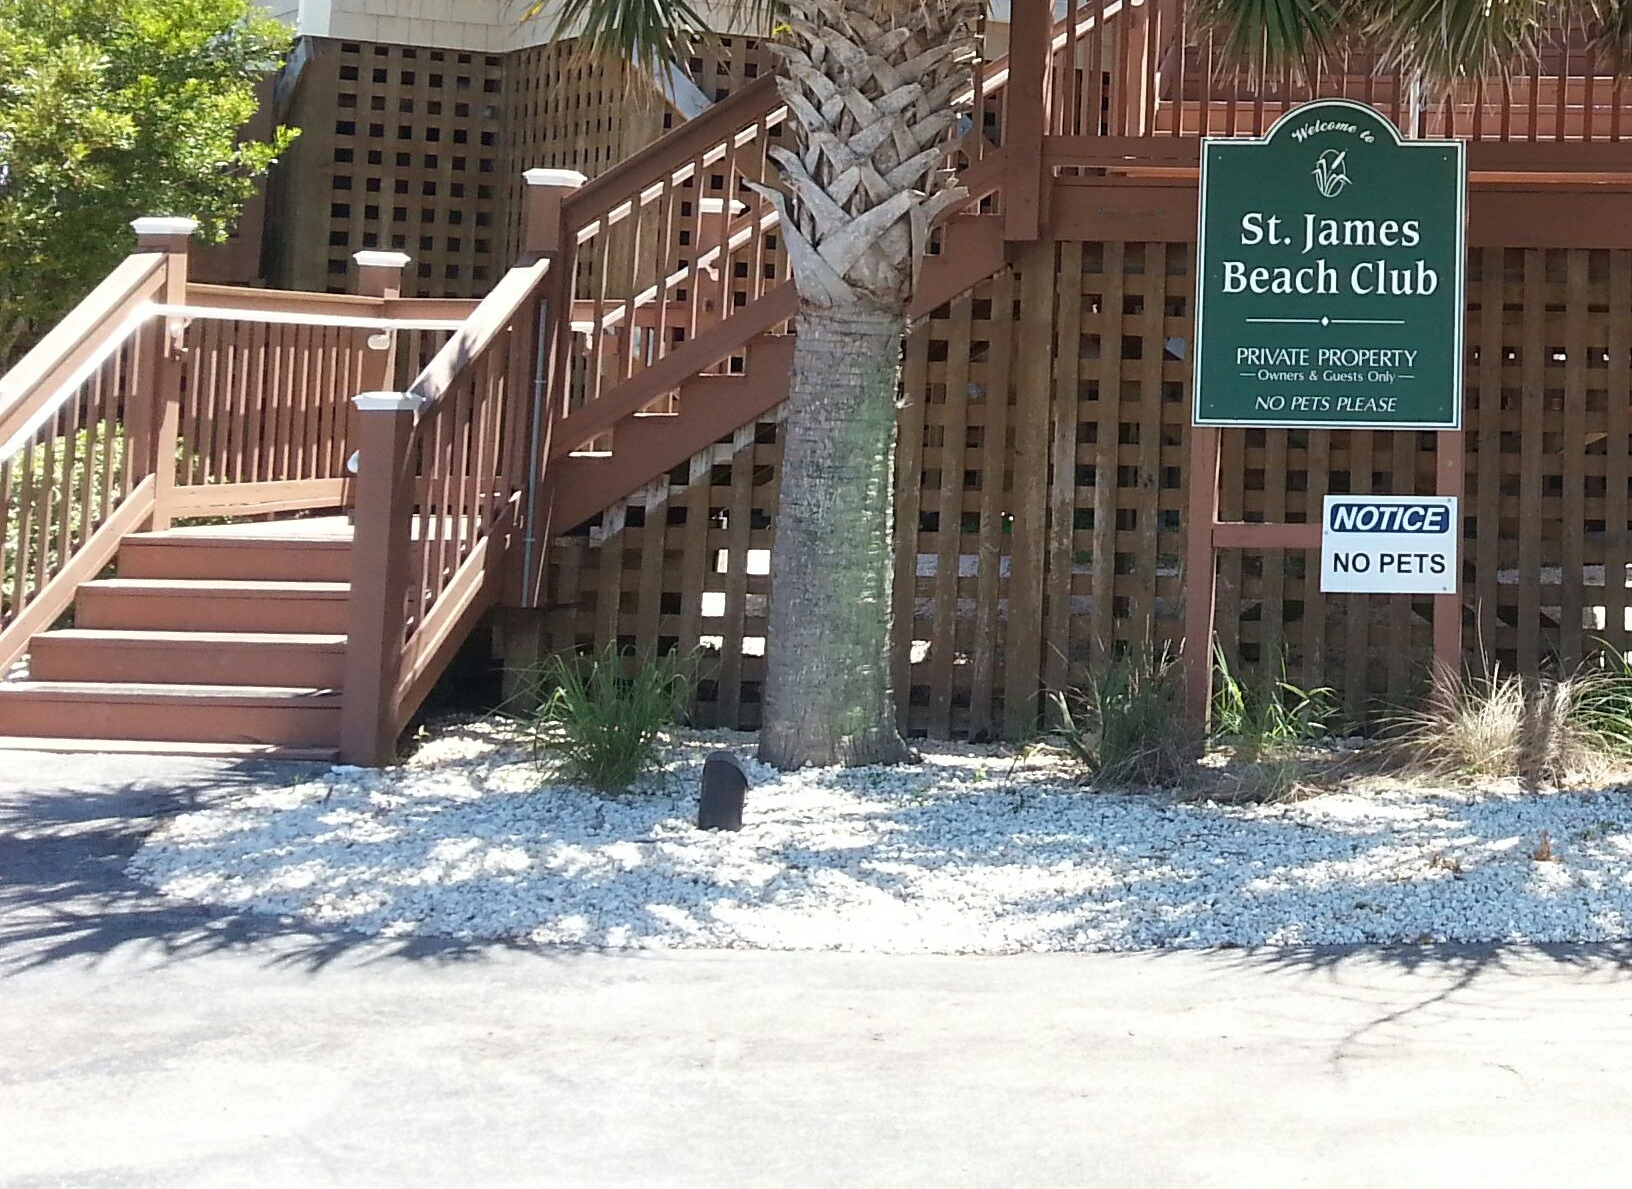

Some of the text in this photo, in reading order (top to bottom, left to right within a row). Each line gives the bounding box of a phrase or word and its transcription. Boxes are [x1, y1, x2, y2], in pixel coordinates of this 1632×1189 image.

[1291, 119, 1375, 144] Welcome to
[1240, 212, 1420, 254] St. James
[1222, 258, 1438, 296] Beach Club
[1236, 347, 1418, 367] PRIVATE PROPERTY
[1257, 369, 1396, 384] Owners & Guests Only
[1254, 396, 1398, 412] NO PETS PLEASE
[1333, 505, 1446, 531] NOTICE
[1333, 552, 1446, 574] NO PETS
